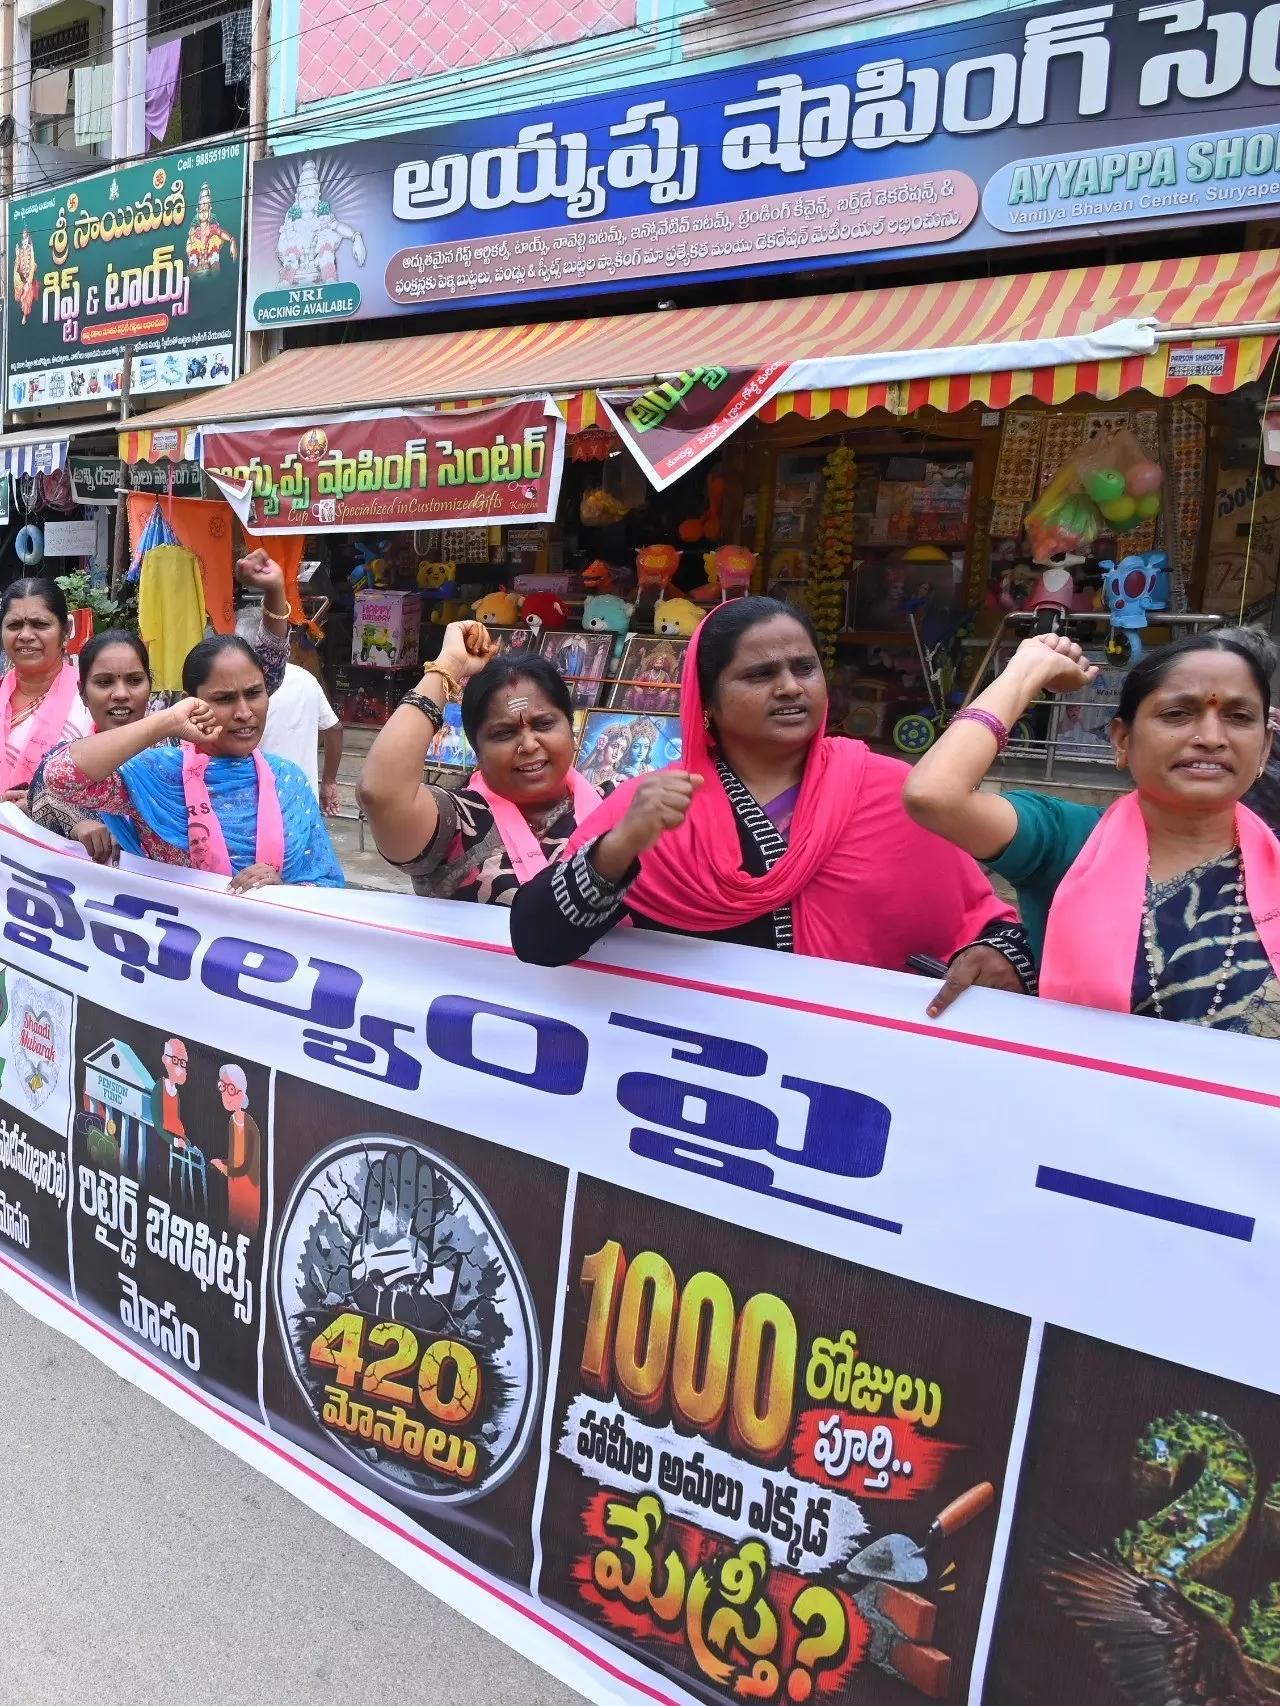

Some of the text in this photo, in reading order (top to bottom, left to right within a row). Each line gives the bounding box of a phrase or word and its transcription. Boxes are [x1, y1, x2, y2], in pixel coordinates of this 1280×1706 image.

[392, 101, 699, 220] అయ్యప్ప
[722, 4, 1114, 175] షాపింగ్
[177, 145, 240, 172] Cell: 9885519106
[1008, 132, 1280, 205] AYYAPPA SHO
[941, 179, 955, 197] &
[1009, 190, 1200, 225] Vanijya Bhavan Center,
[105, 244, 191, 318] టాయ్స్
[528, 265, 536, 279] &
[258, 299, 354, 321] PACKING AVAILABLE
[288, 288, 324, 302] NRI
[317, 438, 429, 500] షాపింగ్
[438, 426, 548, 487] సెంటర్
[288, 507, 310, 527] Cup
[335, 498, 396, 526] Specialized
[362, 604, 392, 616] HAPPY
[362, 613, 391, 623] BIRTHDAY
[23, 1011, 51, 1041] Shaadi
[1, 855, 903, 1236] వైఫల్యంపై
[19, 1029, 57, 1063] Mubarak
[97, 1074, 129, 1099] PENSION
[102, 1088, 125, 1106] FUND
[118, 1272, 202, 1372] మోసం
[578, 1239, 942, 1456] 1000 రోజులు
[308, 1312, 484, 1429] 420
[321, 1385, 478, 1482] మోసాలు
[657, 1450, 745, 1517] అమలు
[747, 1482, 832, 1572] ఎక్కడ
